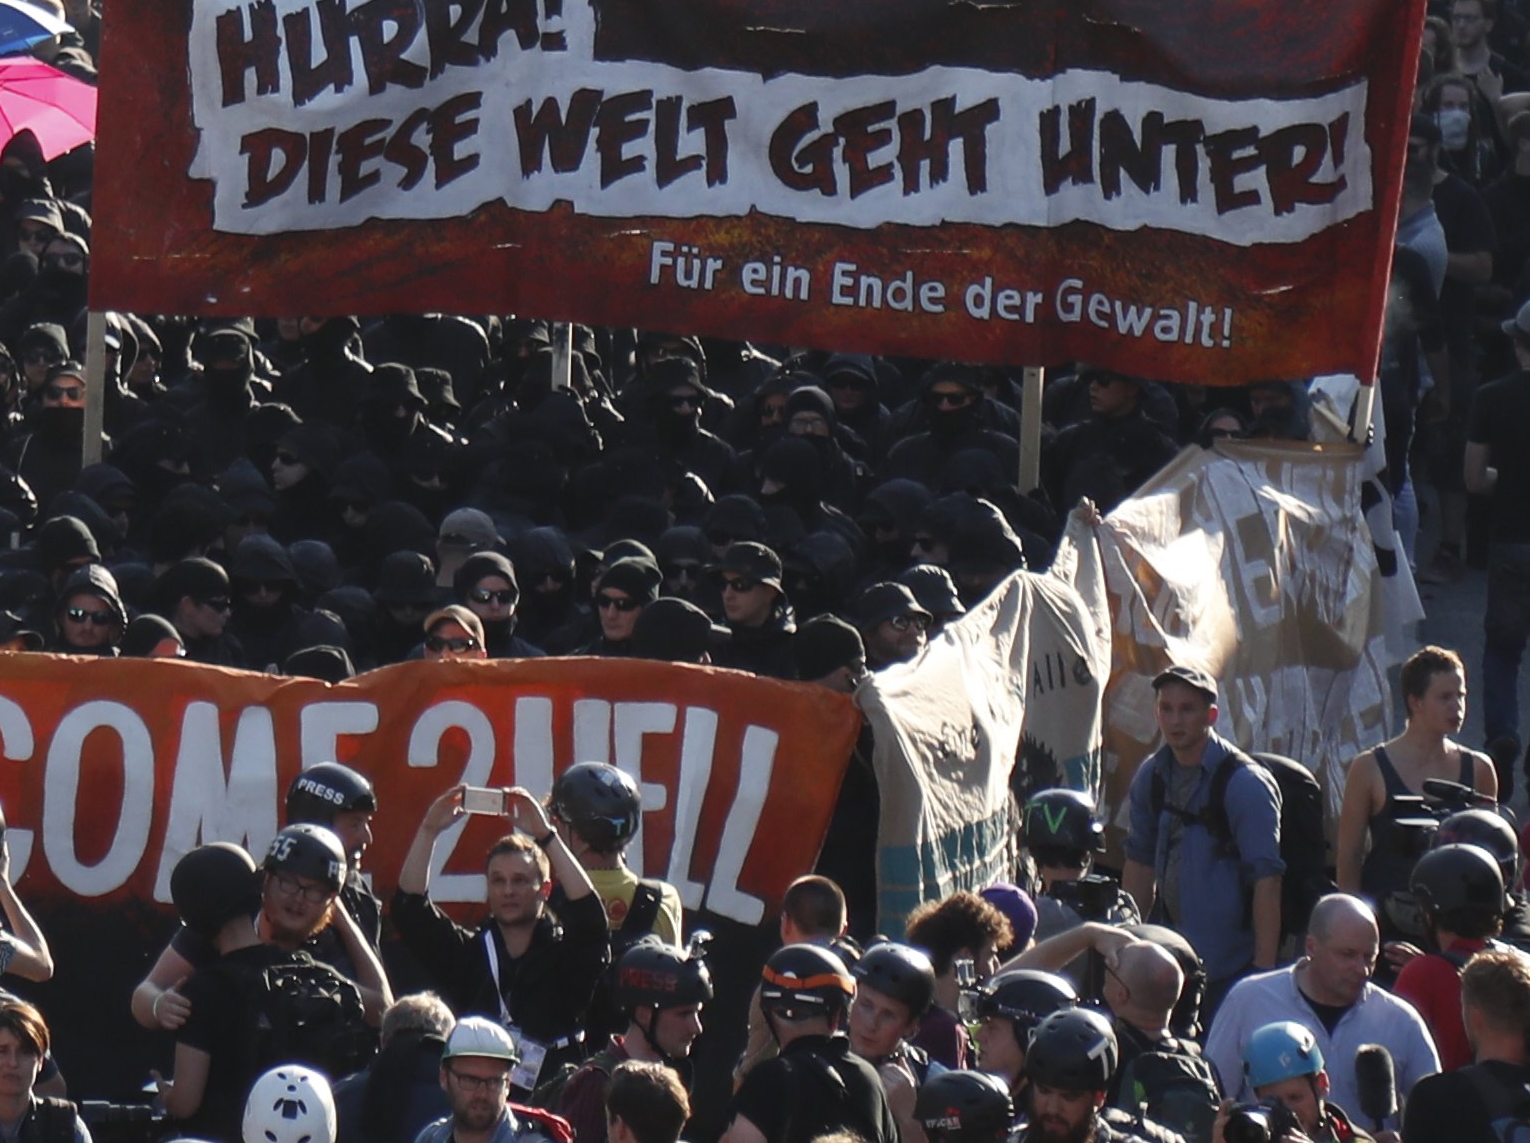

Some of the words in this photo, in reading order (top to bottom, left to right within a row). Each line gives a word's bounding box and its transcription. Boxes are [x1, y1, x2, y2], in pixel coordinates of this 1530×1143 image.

[239, 91, 484, 210] DIESE
[512, 88, 737, 190] WELT
[769, 93, 1001, 199] GEHT
[1038, 96, 1351, 216] UNTER!
[648, 239, 724, 292] Für
[740, 253, 812, 302] ein
[830, 260, 948, 314] Ende
[964, 275, 1044, 325] der
[1054, 277, 1235, 349] Gewalt!
[297, 777, 346, 806] PRESS
